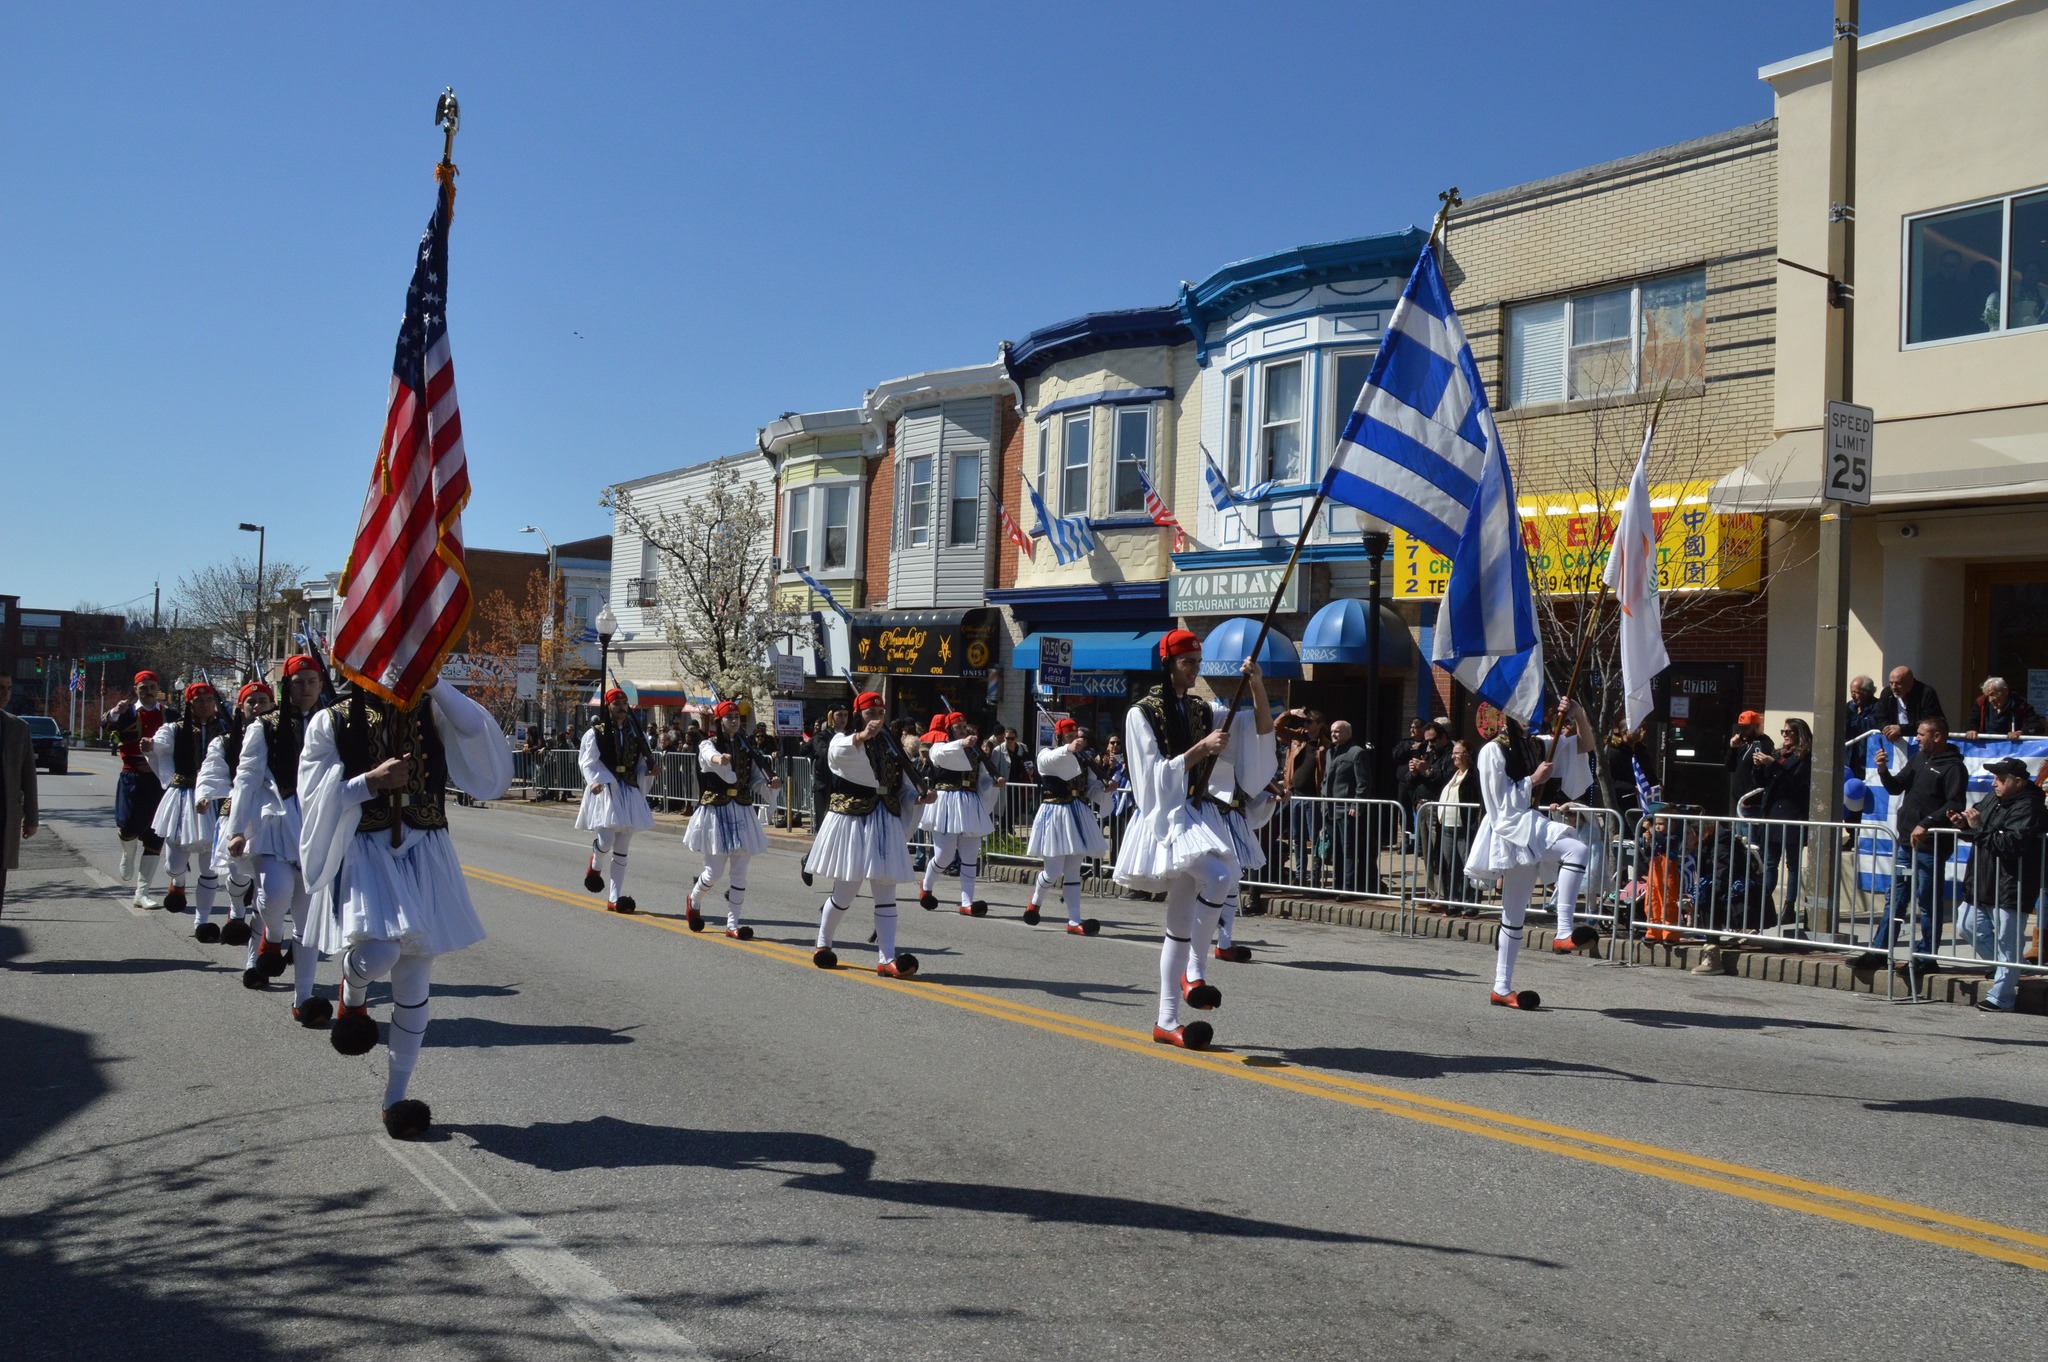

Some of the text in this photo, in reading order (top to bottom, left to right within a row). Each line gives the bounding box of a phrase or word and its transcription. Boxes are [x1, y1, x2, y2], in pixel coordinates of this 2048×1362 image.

[1832, 413, 1870, 433] SPEED
[1835, 433, 1866, 453] LIMIT
[1831, 453, 1867, 493] 25
[1567, 511, 1673, 548] EAT
[1177, 570, 1286, 598] ZORBA'S
[1175, 598, 1236, 612] RESTAURANT
[1302, 648, 1337, 661] ZORBA'S
[1047, 666, 1063, 675] PAY
[1201, 661, 1238, 675] ZORBA'S
[1044, 675, 1066, 684] HERE
[1083, 676, 1127, 694] GREEKS
[1683, 680, 1717, 693] 4712
